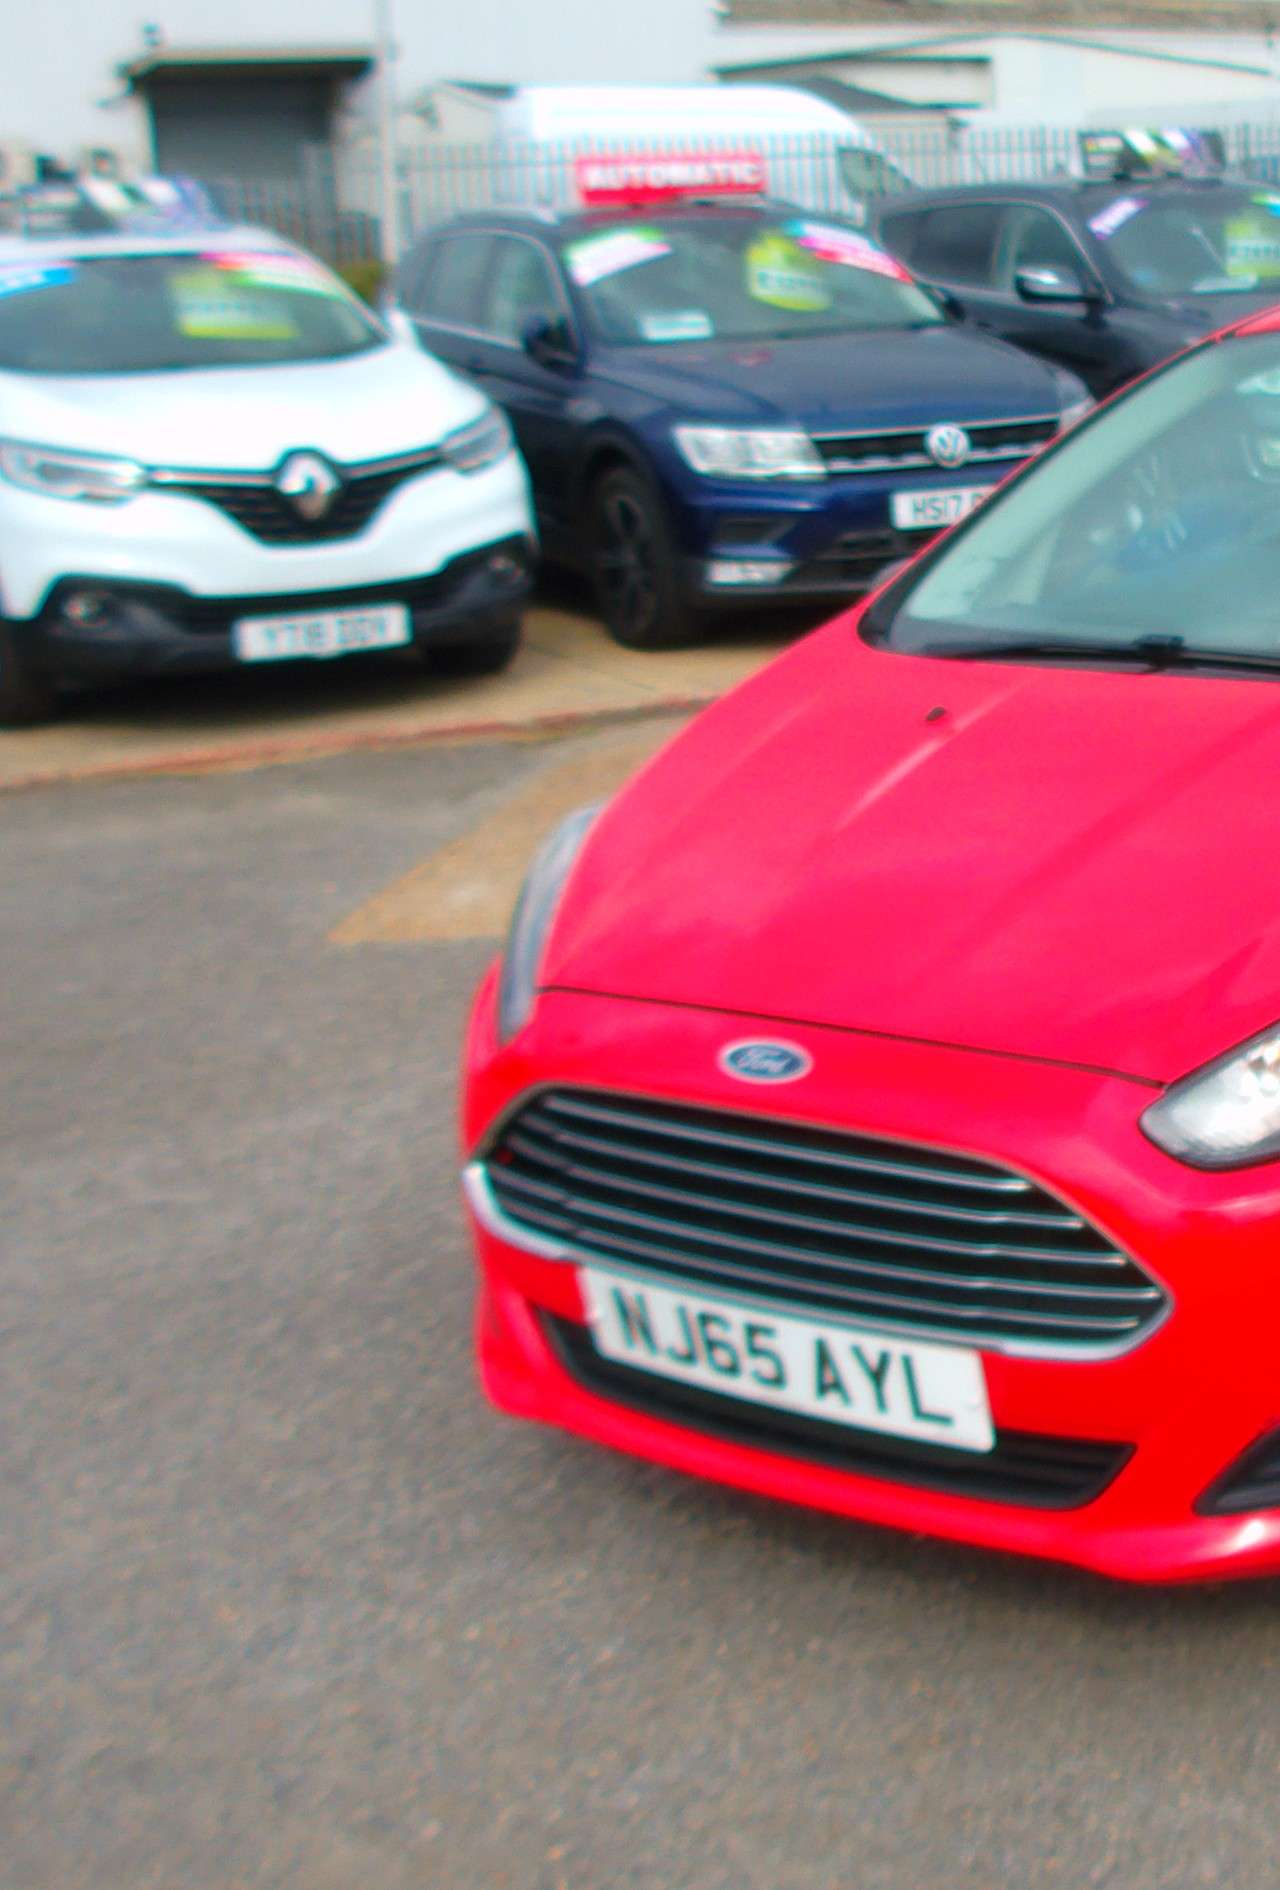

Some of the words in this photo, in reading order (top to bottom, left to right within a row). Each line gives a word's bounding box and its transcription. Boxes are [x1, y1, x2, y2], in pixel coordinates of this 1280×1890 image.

[585, 161, 759, 188] AUTOMATIC
[911, 493, 963, 520] HS17
[731, 1045, 792, 1074] Ford
[611, 1286, 788, 1390] NJ65
[812, 1337, 955, 1427] AYL
